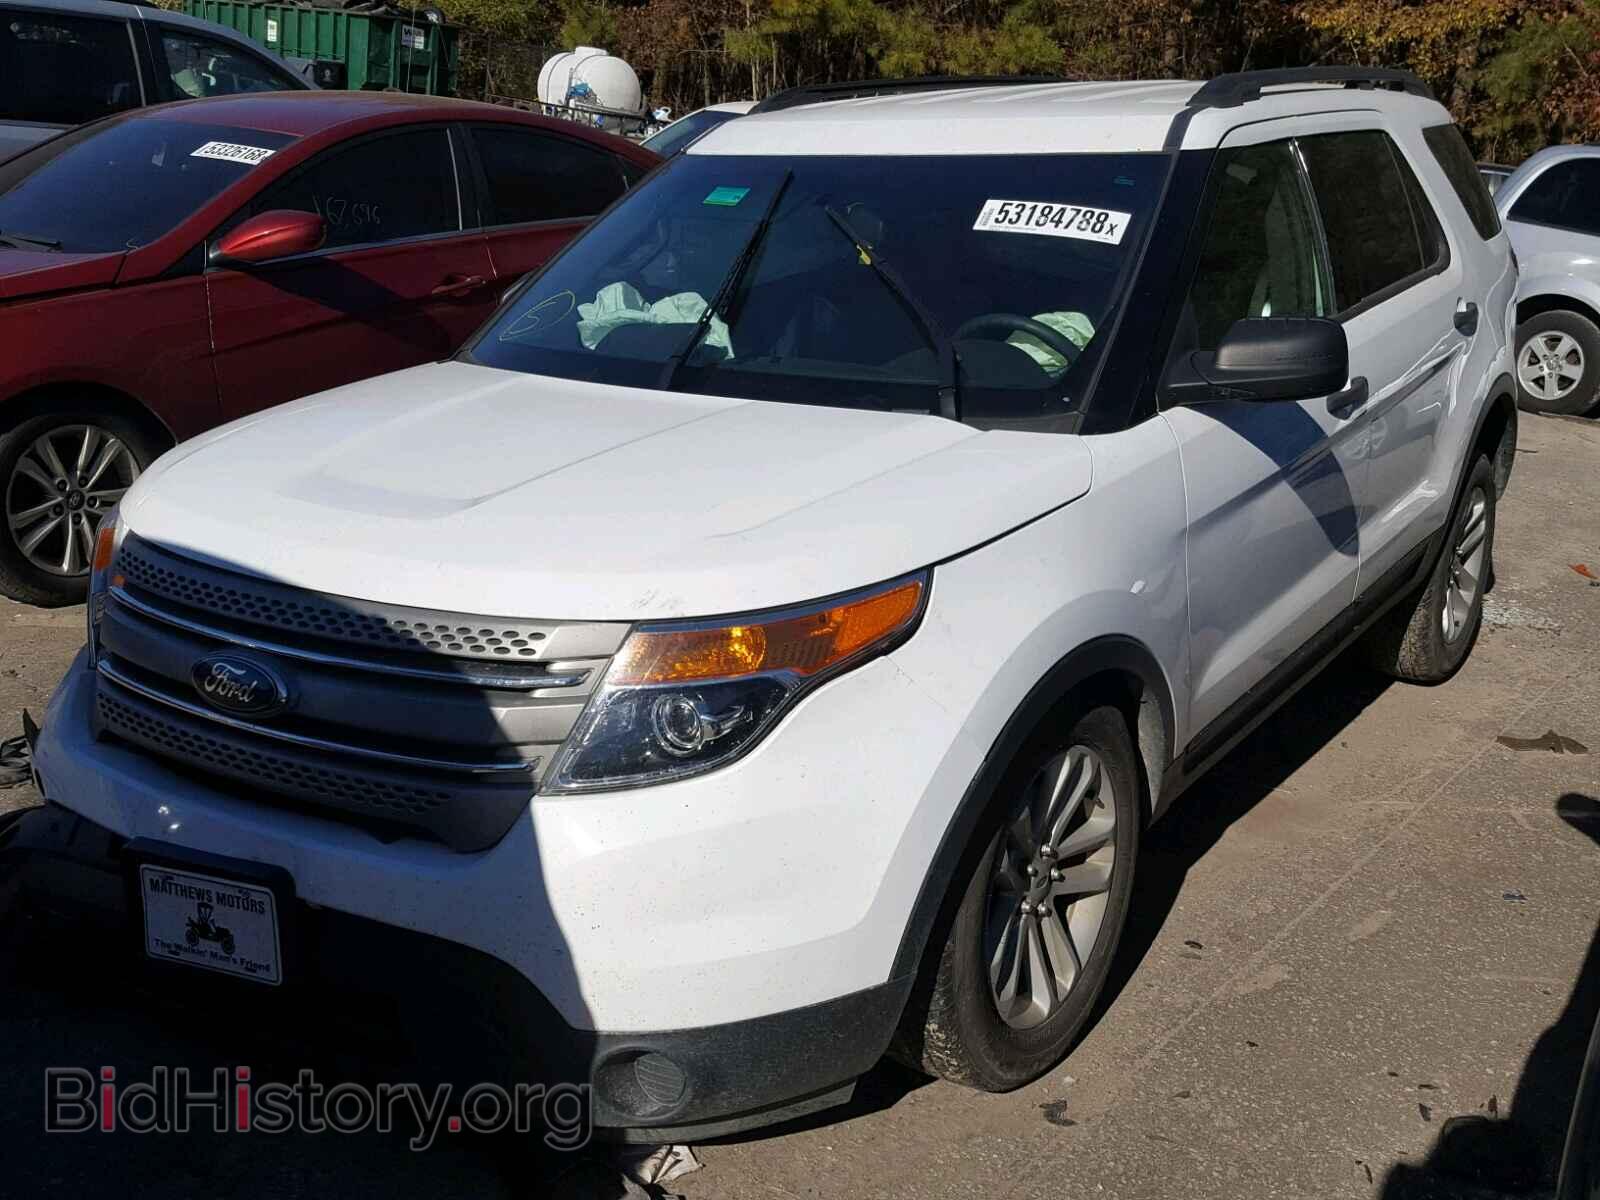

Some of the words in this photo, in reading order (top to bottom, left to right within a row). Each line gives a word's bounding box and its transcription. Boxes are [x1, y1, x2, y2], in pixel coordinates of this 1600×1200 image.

[204, 662, 258, 702] Ford
[149, 877, 213, 902] MATTHEWS
[216, 891, 266, 914] MOTORS
